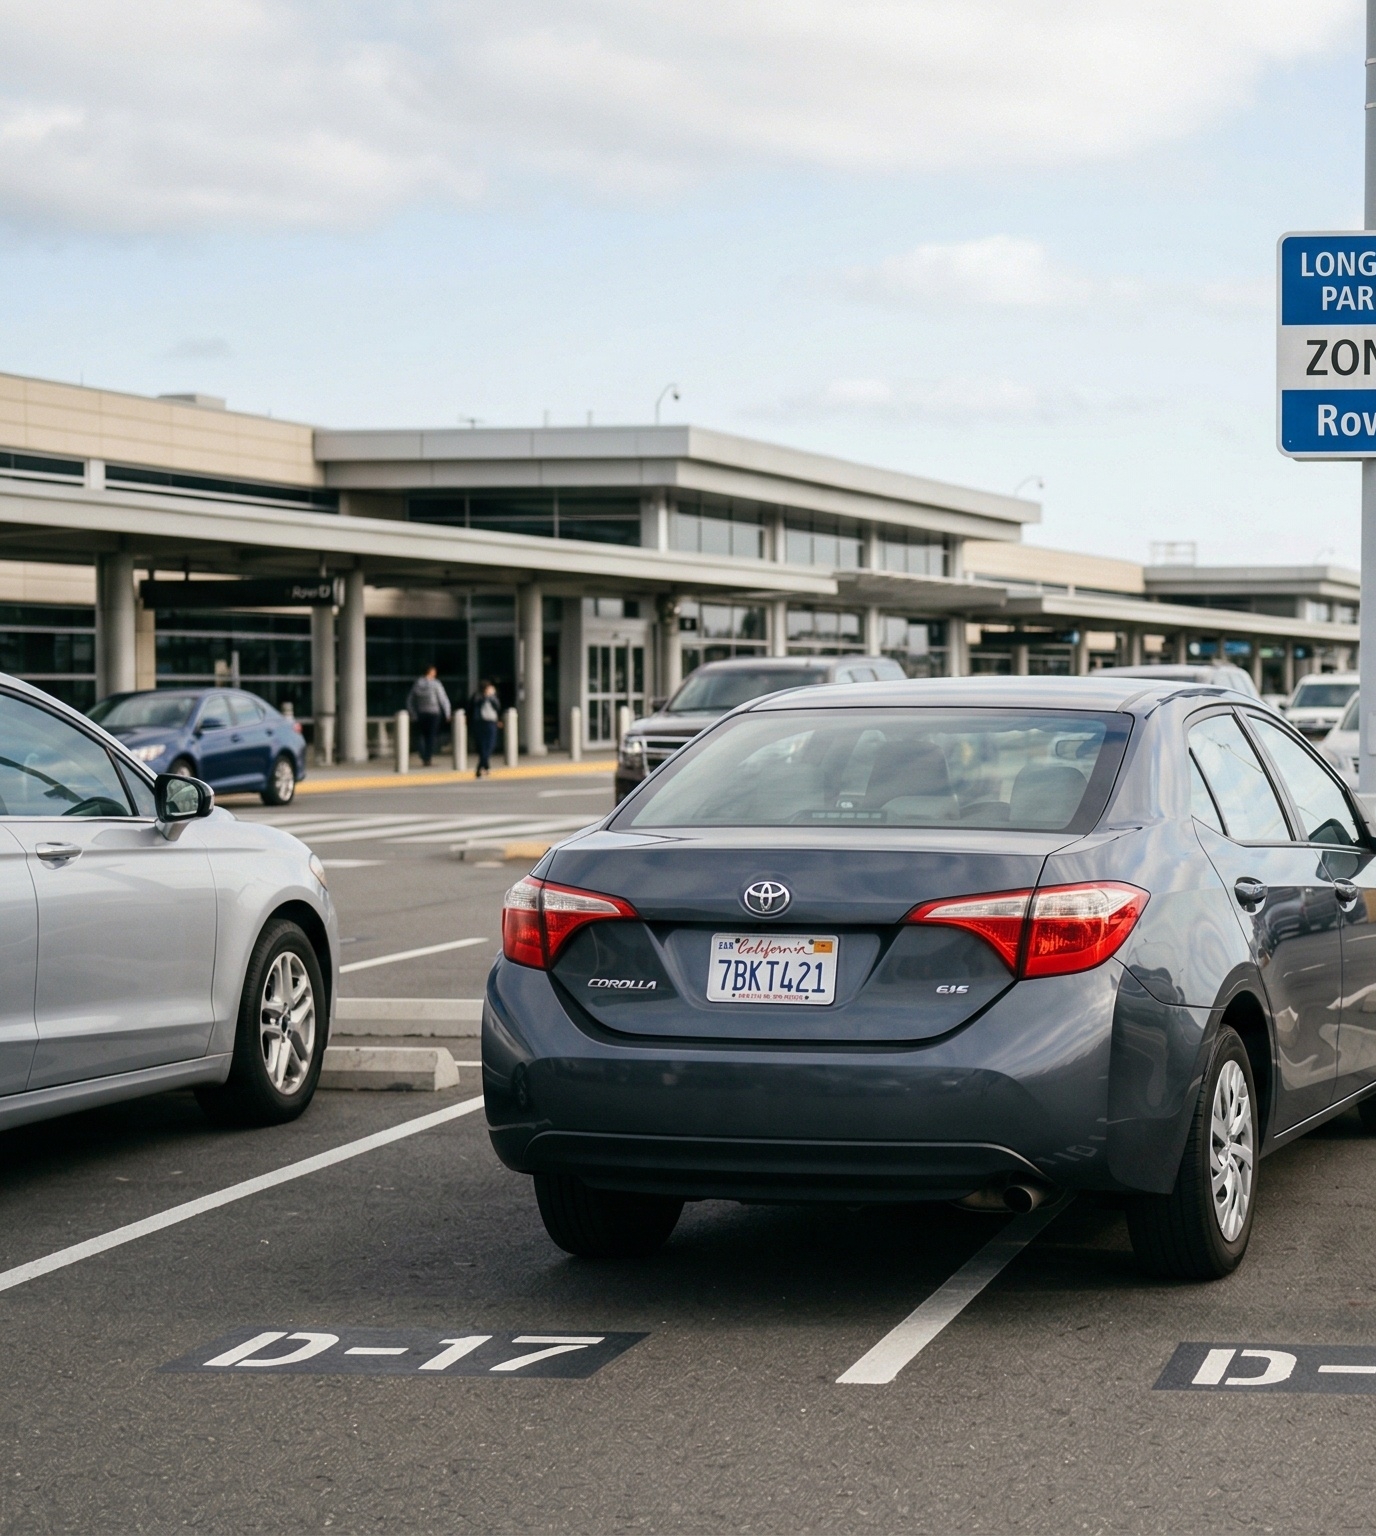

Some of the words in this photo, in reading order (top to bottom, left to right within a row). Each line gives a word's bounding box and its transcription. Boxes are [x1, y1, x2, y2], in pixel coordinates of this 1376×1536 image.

[737, 938, 814, 959] California
[587, 978, 657, 990] COROLLA
[718, 959, 826, 993] 7BKT421
[202, 1331, 606, 1372] D-17
